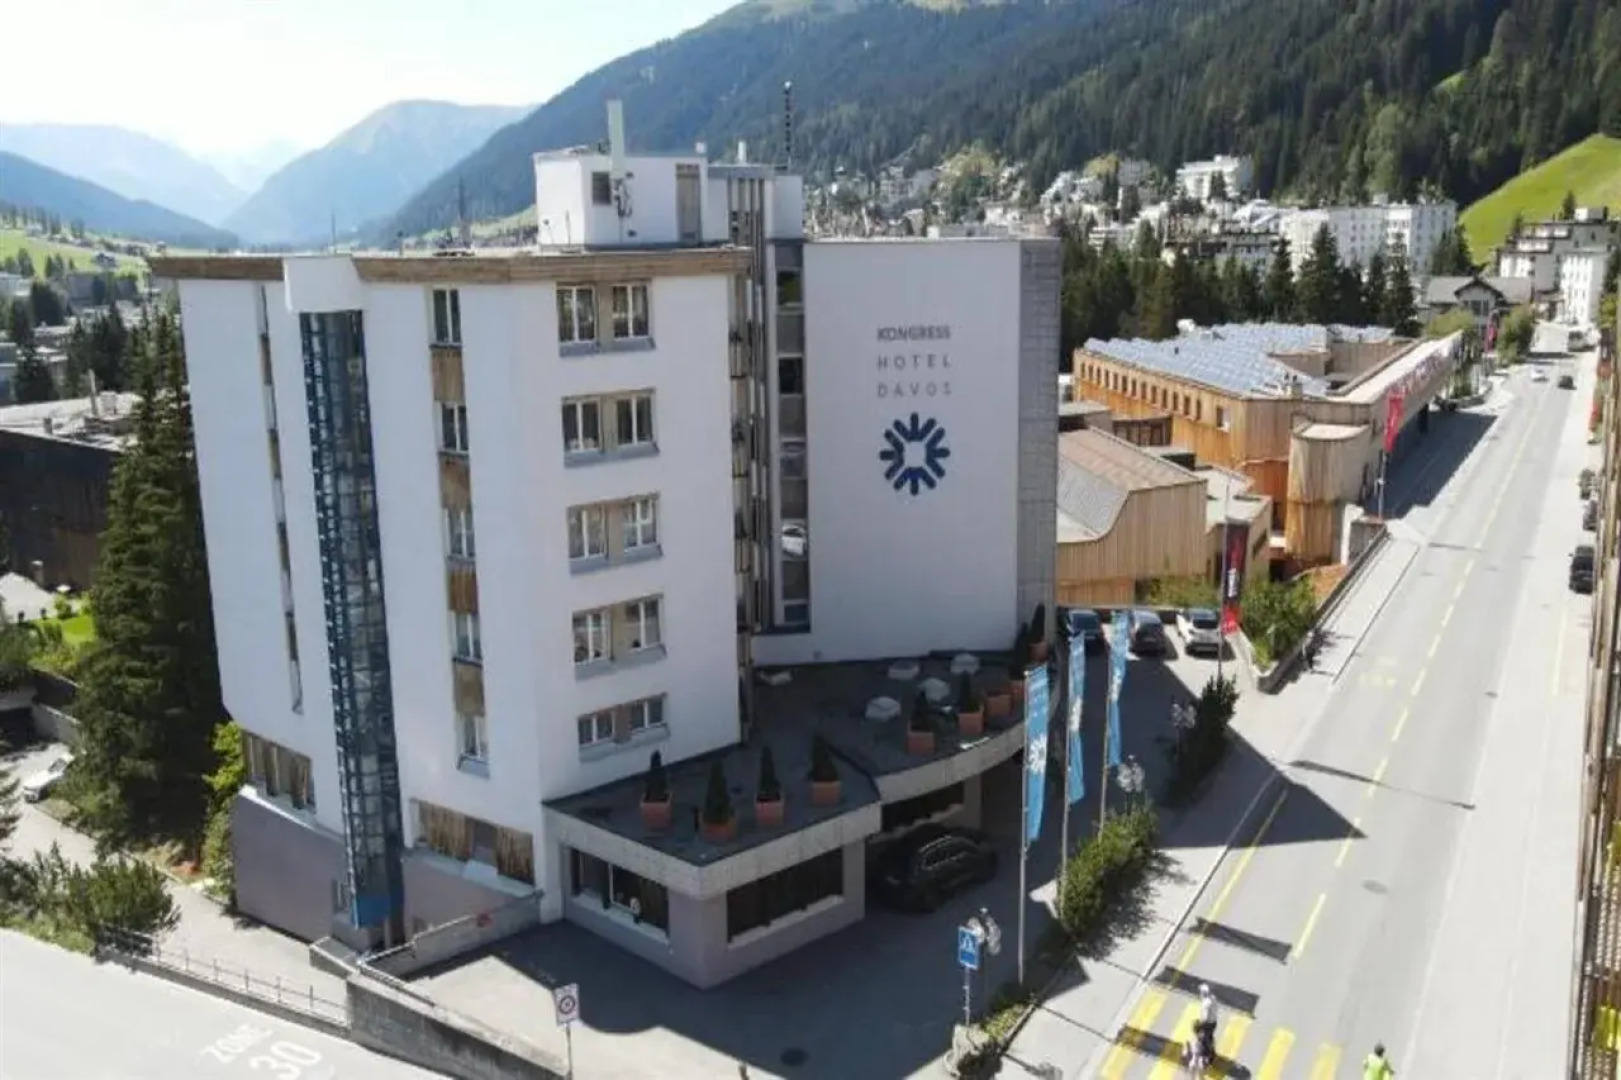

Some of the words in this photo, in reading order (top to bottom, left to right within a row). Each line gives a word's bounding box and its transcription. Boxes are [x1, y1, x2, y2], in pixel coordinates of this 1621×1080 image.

[877, 325, 951, 341] KONGRESS
[877, 354, 951, 370] HOTEL
[877, 382, 951, 398] DAVOS
[249, 1040, 322, 1080] 30
